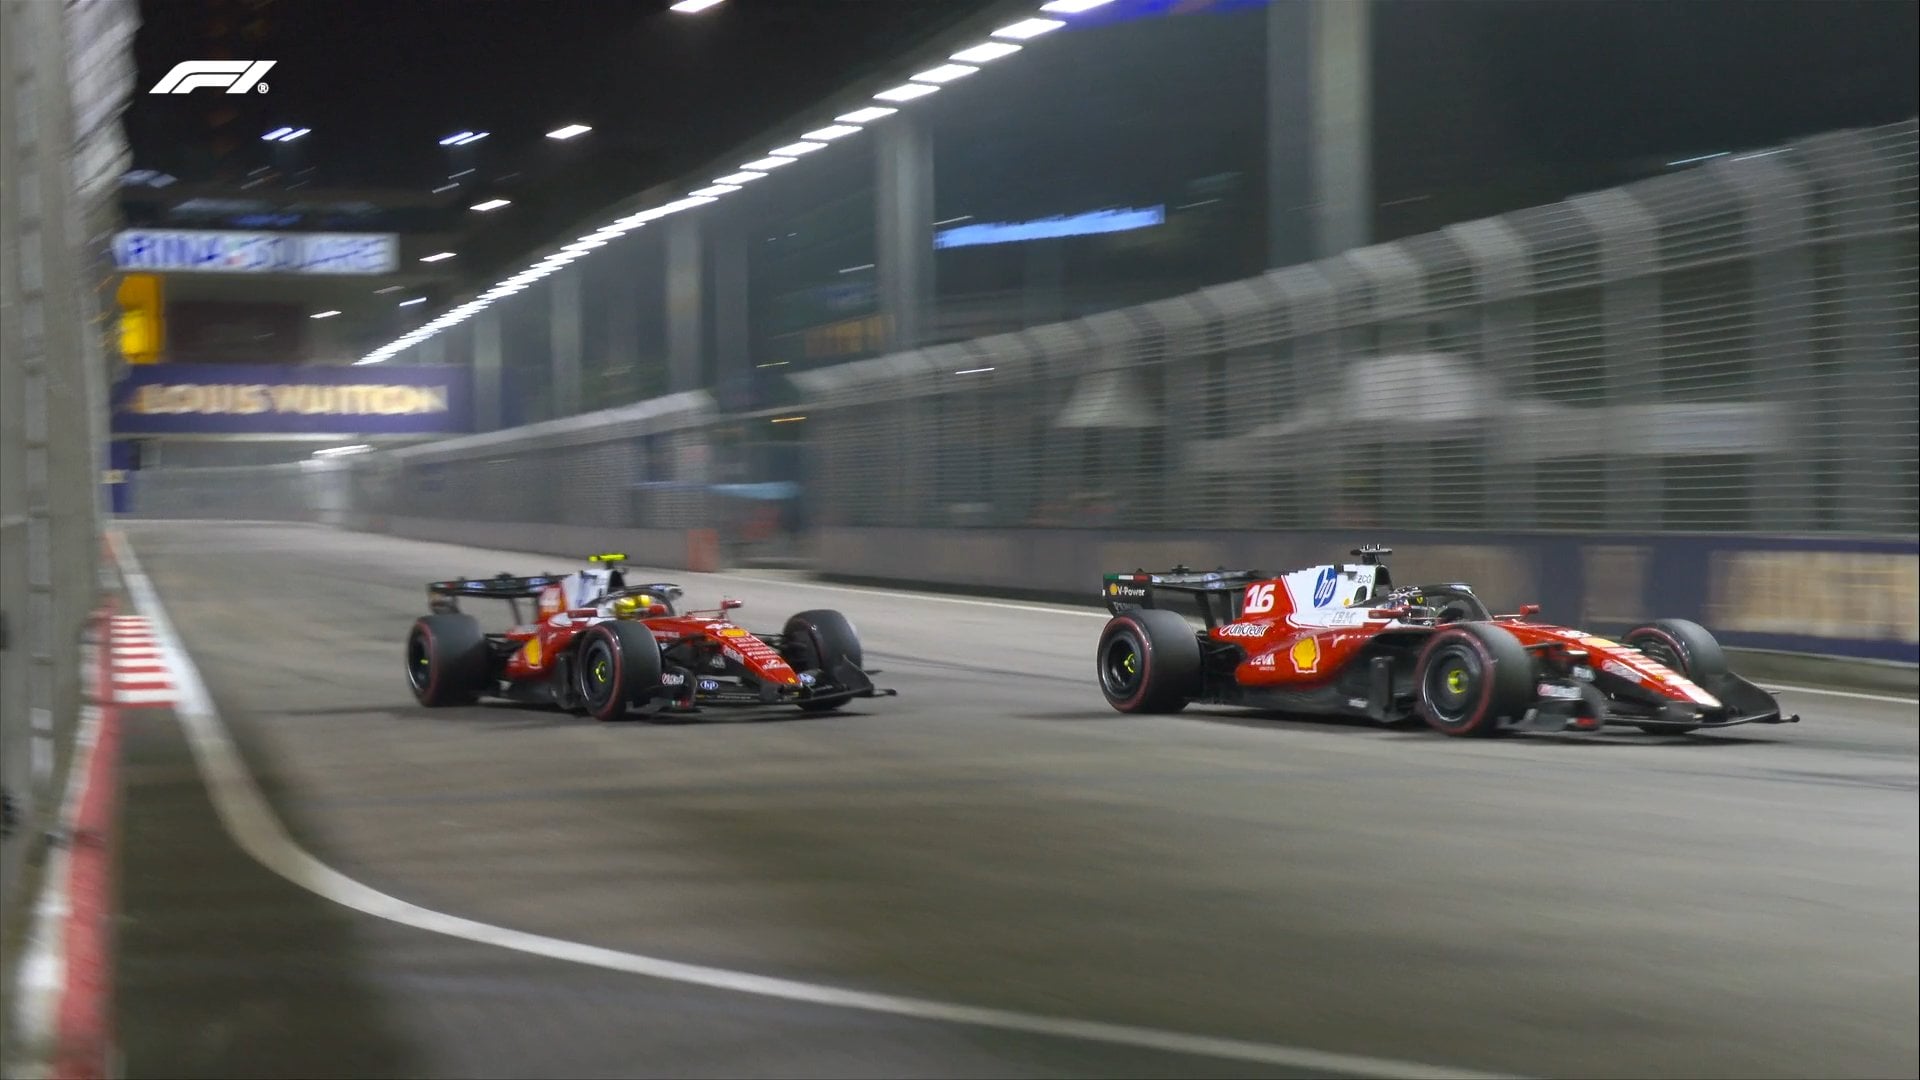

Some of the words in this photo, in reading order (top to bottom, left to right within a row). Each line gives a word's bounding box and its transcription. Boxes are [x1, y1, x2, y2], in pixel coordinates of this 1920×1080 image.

[1117, 585, 1145, 597] V-Power
[1245, 584, 1276, 614] 16
[1315, 568, 1336, 608] hp
